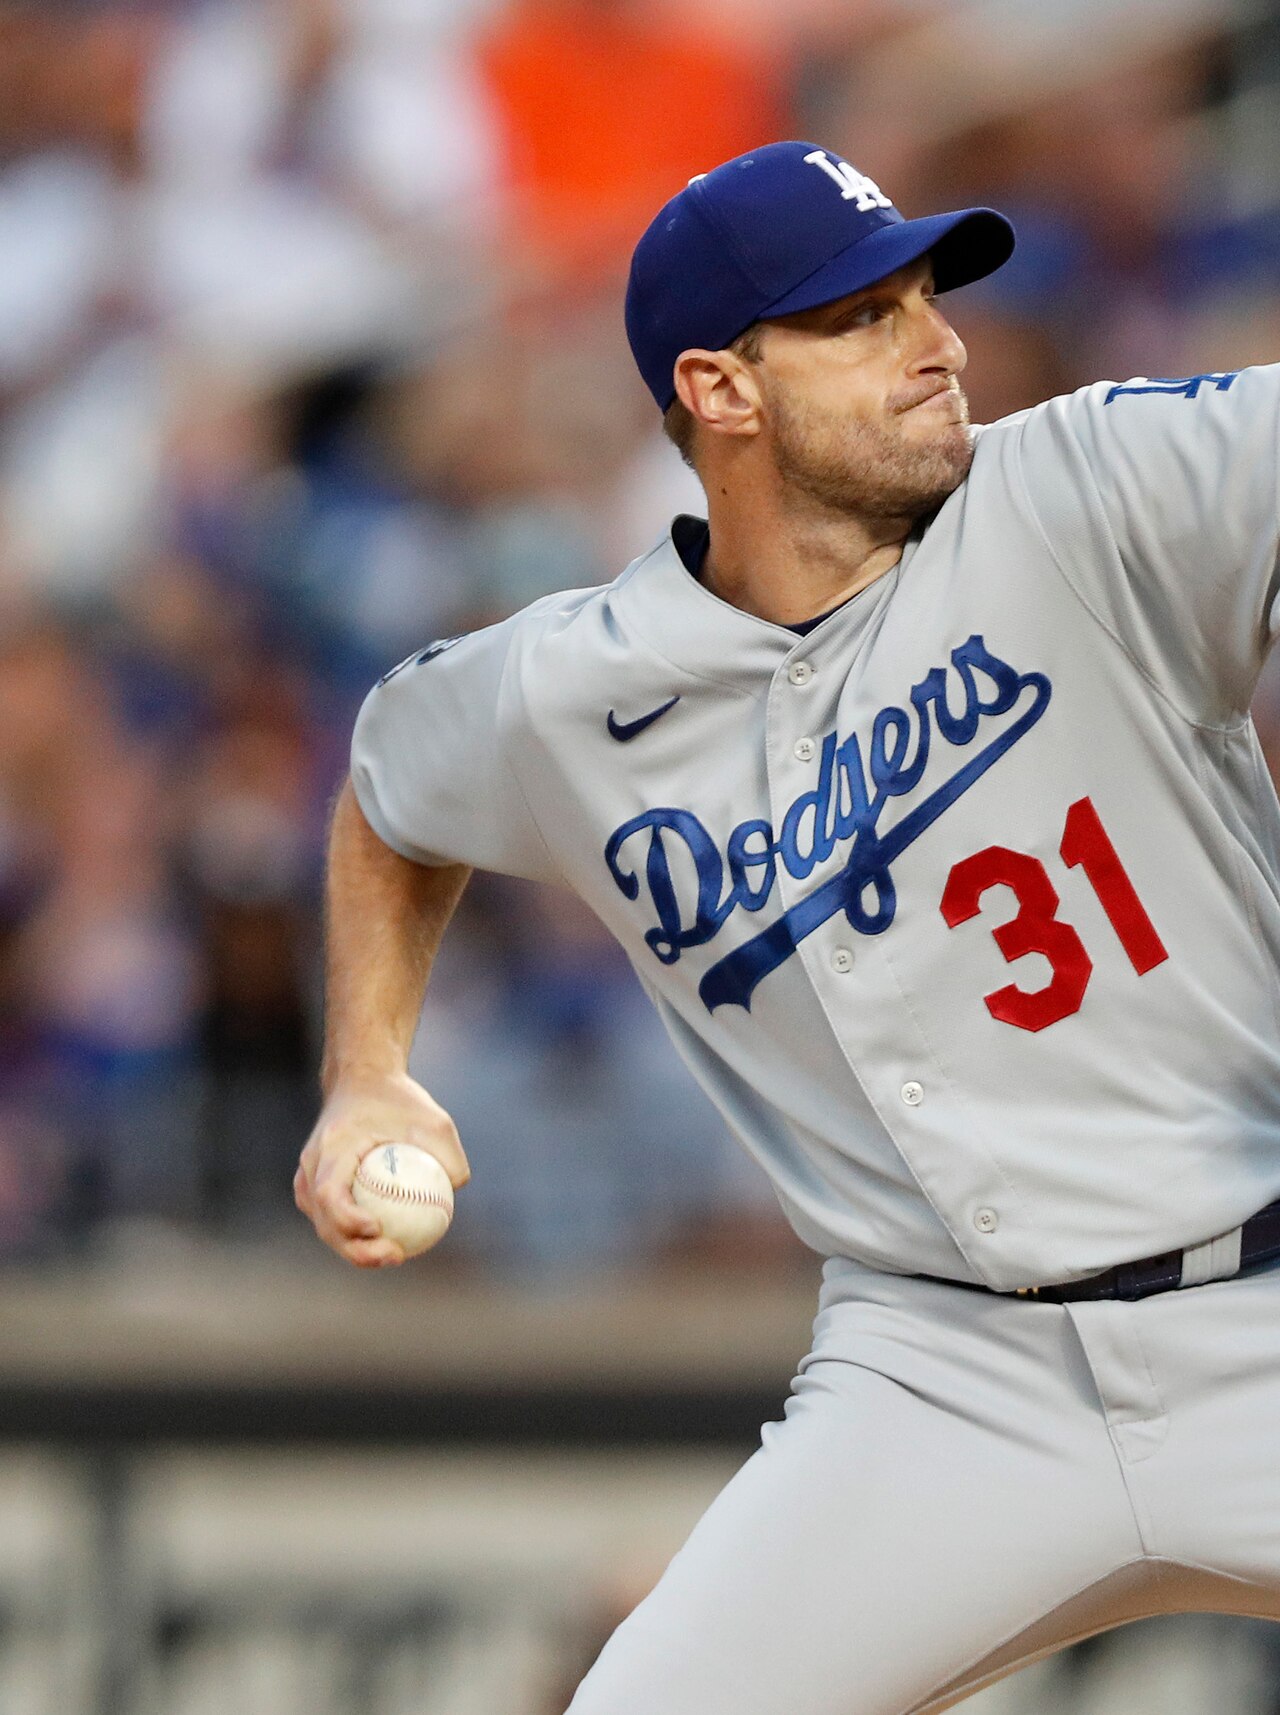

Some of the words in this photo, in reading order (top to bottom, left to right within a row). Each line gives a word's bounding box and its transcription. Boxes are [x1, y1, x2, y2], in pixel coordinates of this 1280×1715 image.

[802, 150, 893, 213] LA
[604, 634, 1052, 966] Dodgers
[939, 796, 1169, 1032] 31
